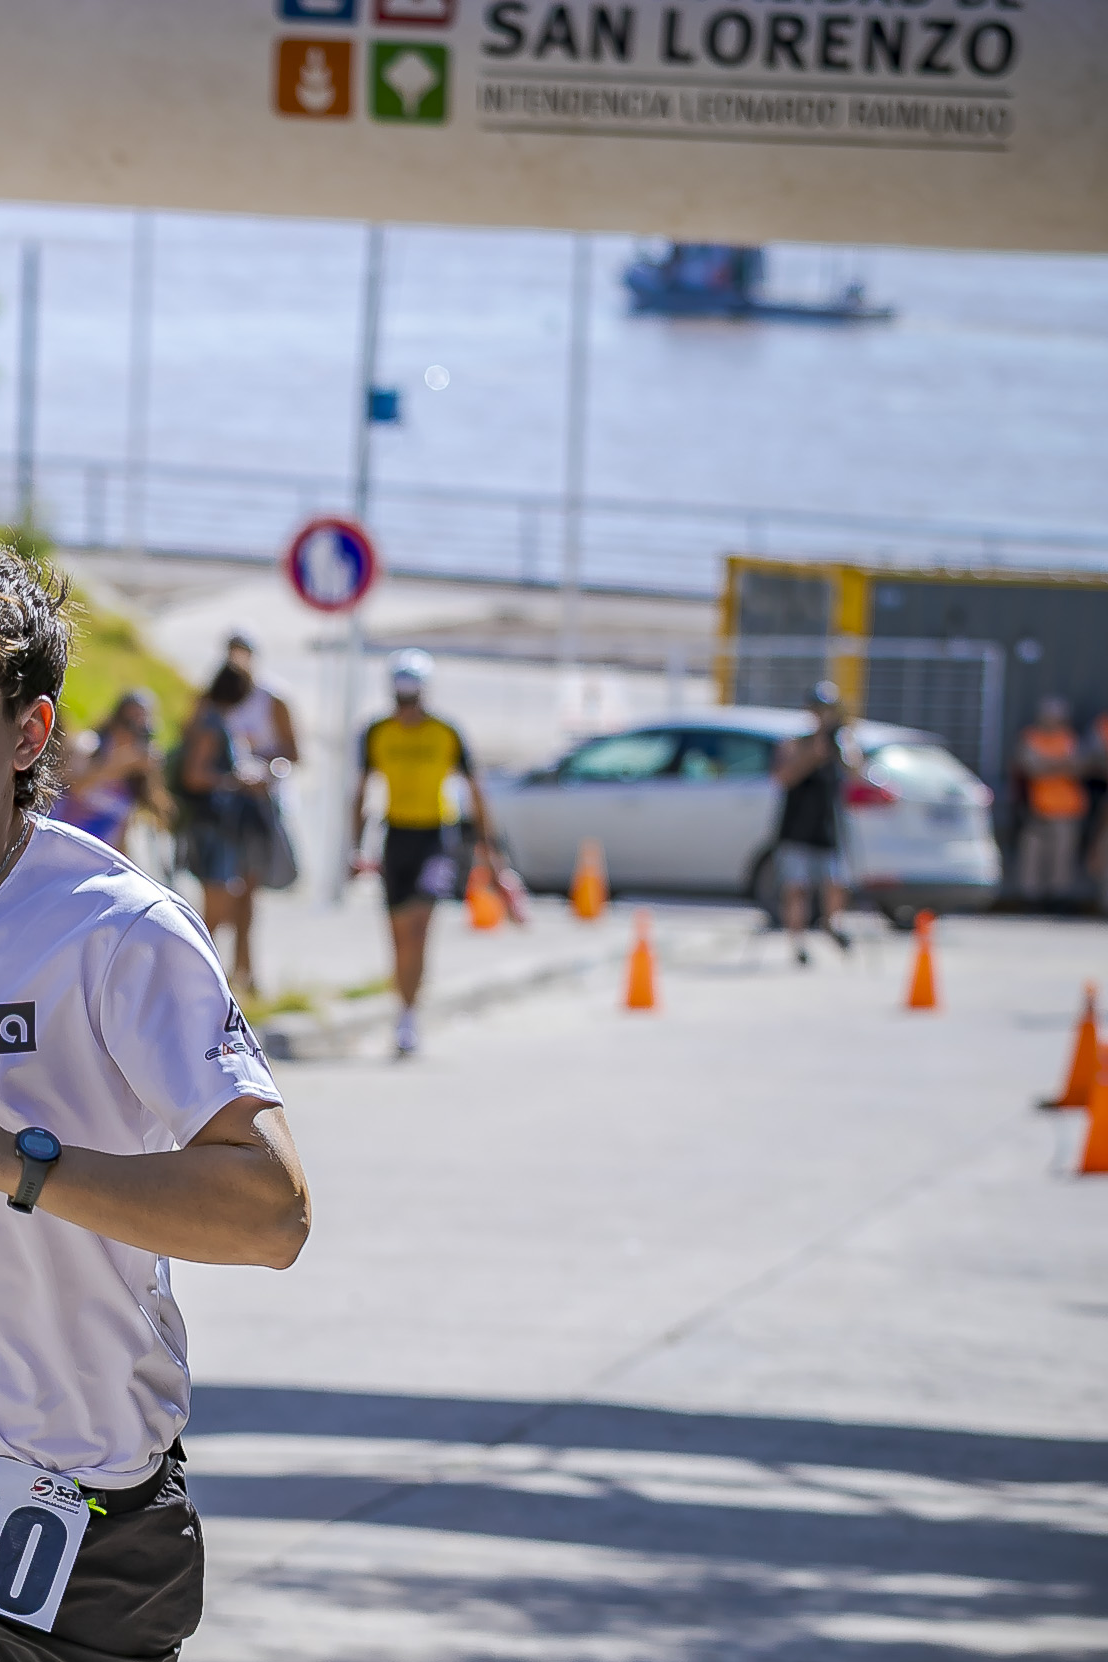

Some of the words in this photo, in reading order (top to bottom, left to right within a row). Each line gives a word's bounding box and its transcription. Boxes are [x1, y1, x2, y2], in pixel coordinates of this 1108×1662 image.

[480, 0, 636, 64] SAN
[658, 8, 1018, 79] LORENZO
[476, 82, 672, 120] INTENDENCIA
[679, 92, 838, 128] LEONARDO
[847, 98, 1014, 137] RAIMUNDO
